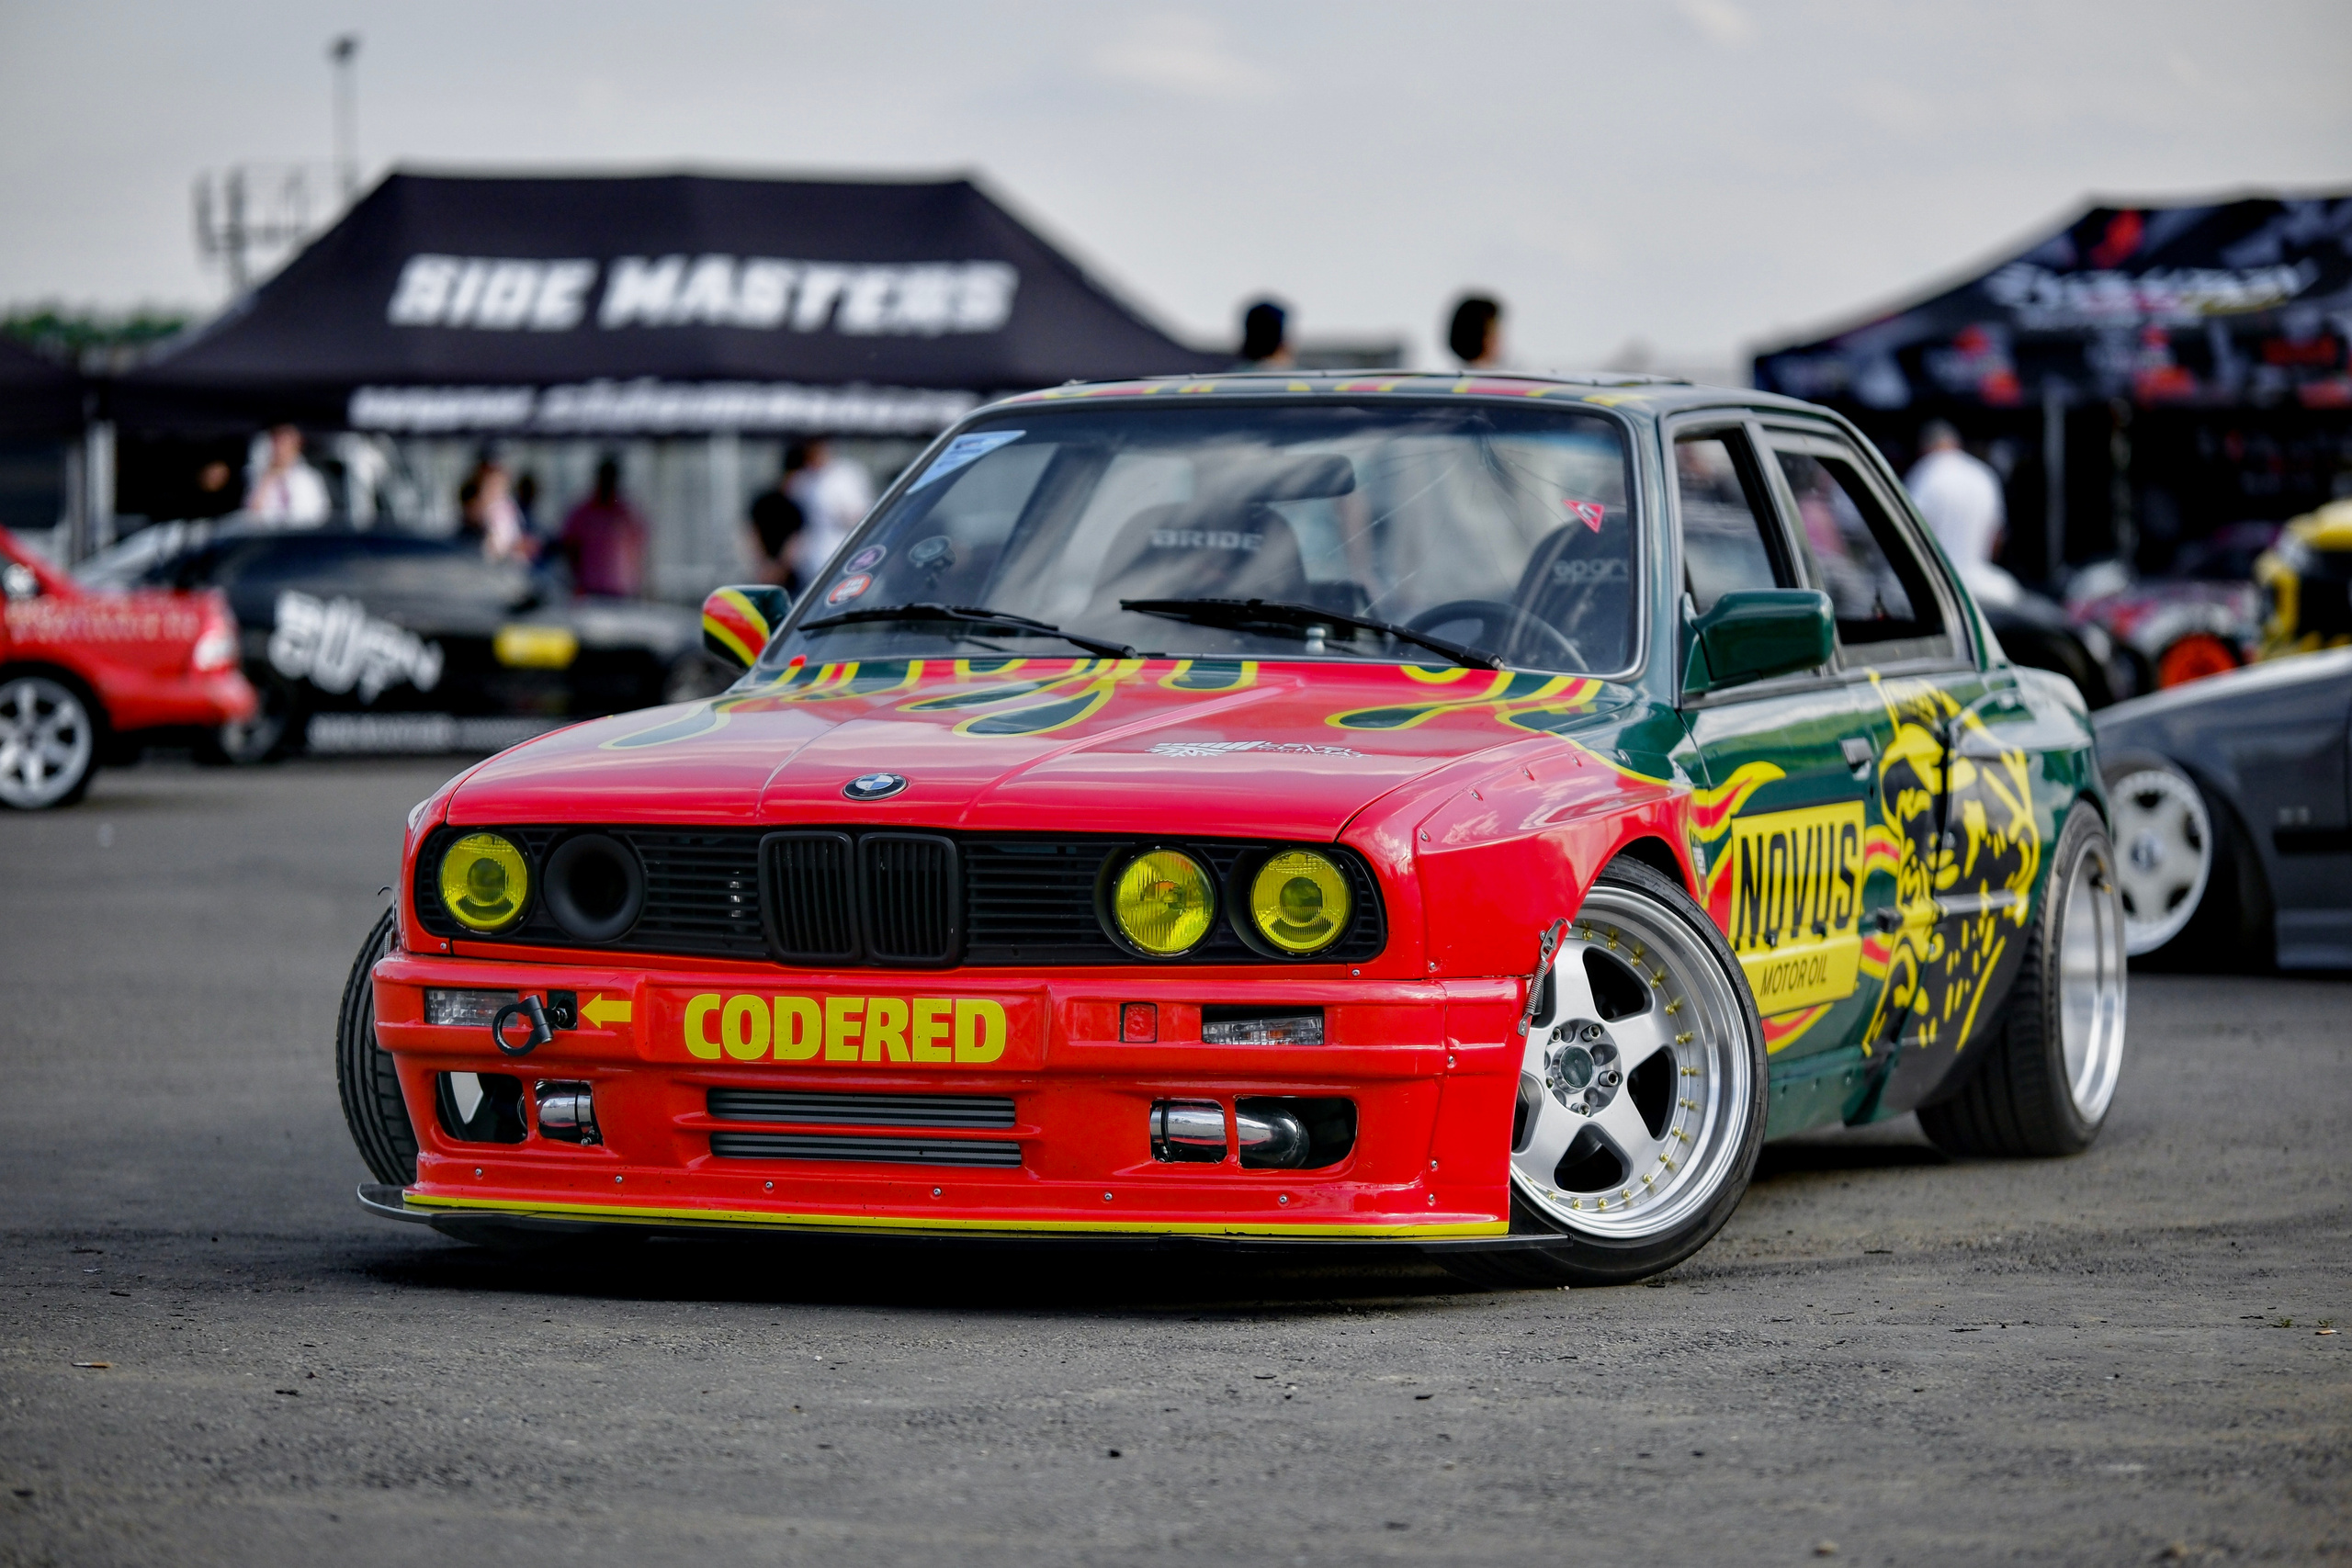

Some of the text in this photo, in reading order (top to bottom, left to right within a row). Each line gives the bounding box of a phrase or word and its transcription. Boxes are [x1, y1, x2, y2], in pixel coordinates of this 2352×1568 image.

[389, 254, 1018, 336] SIDE MASTERS
[1735, 819, 1857, 951] NOVUS
[1759, 953, 1827, 998] MOTOR OIL
[684, 993, 1007, 1063] CODERED
